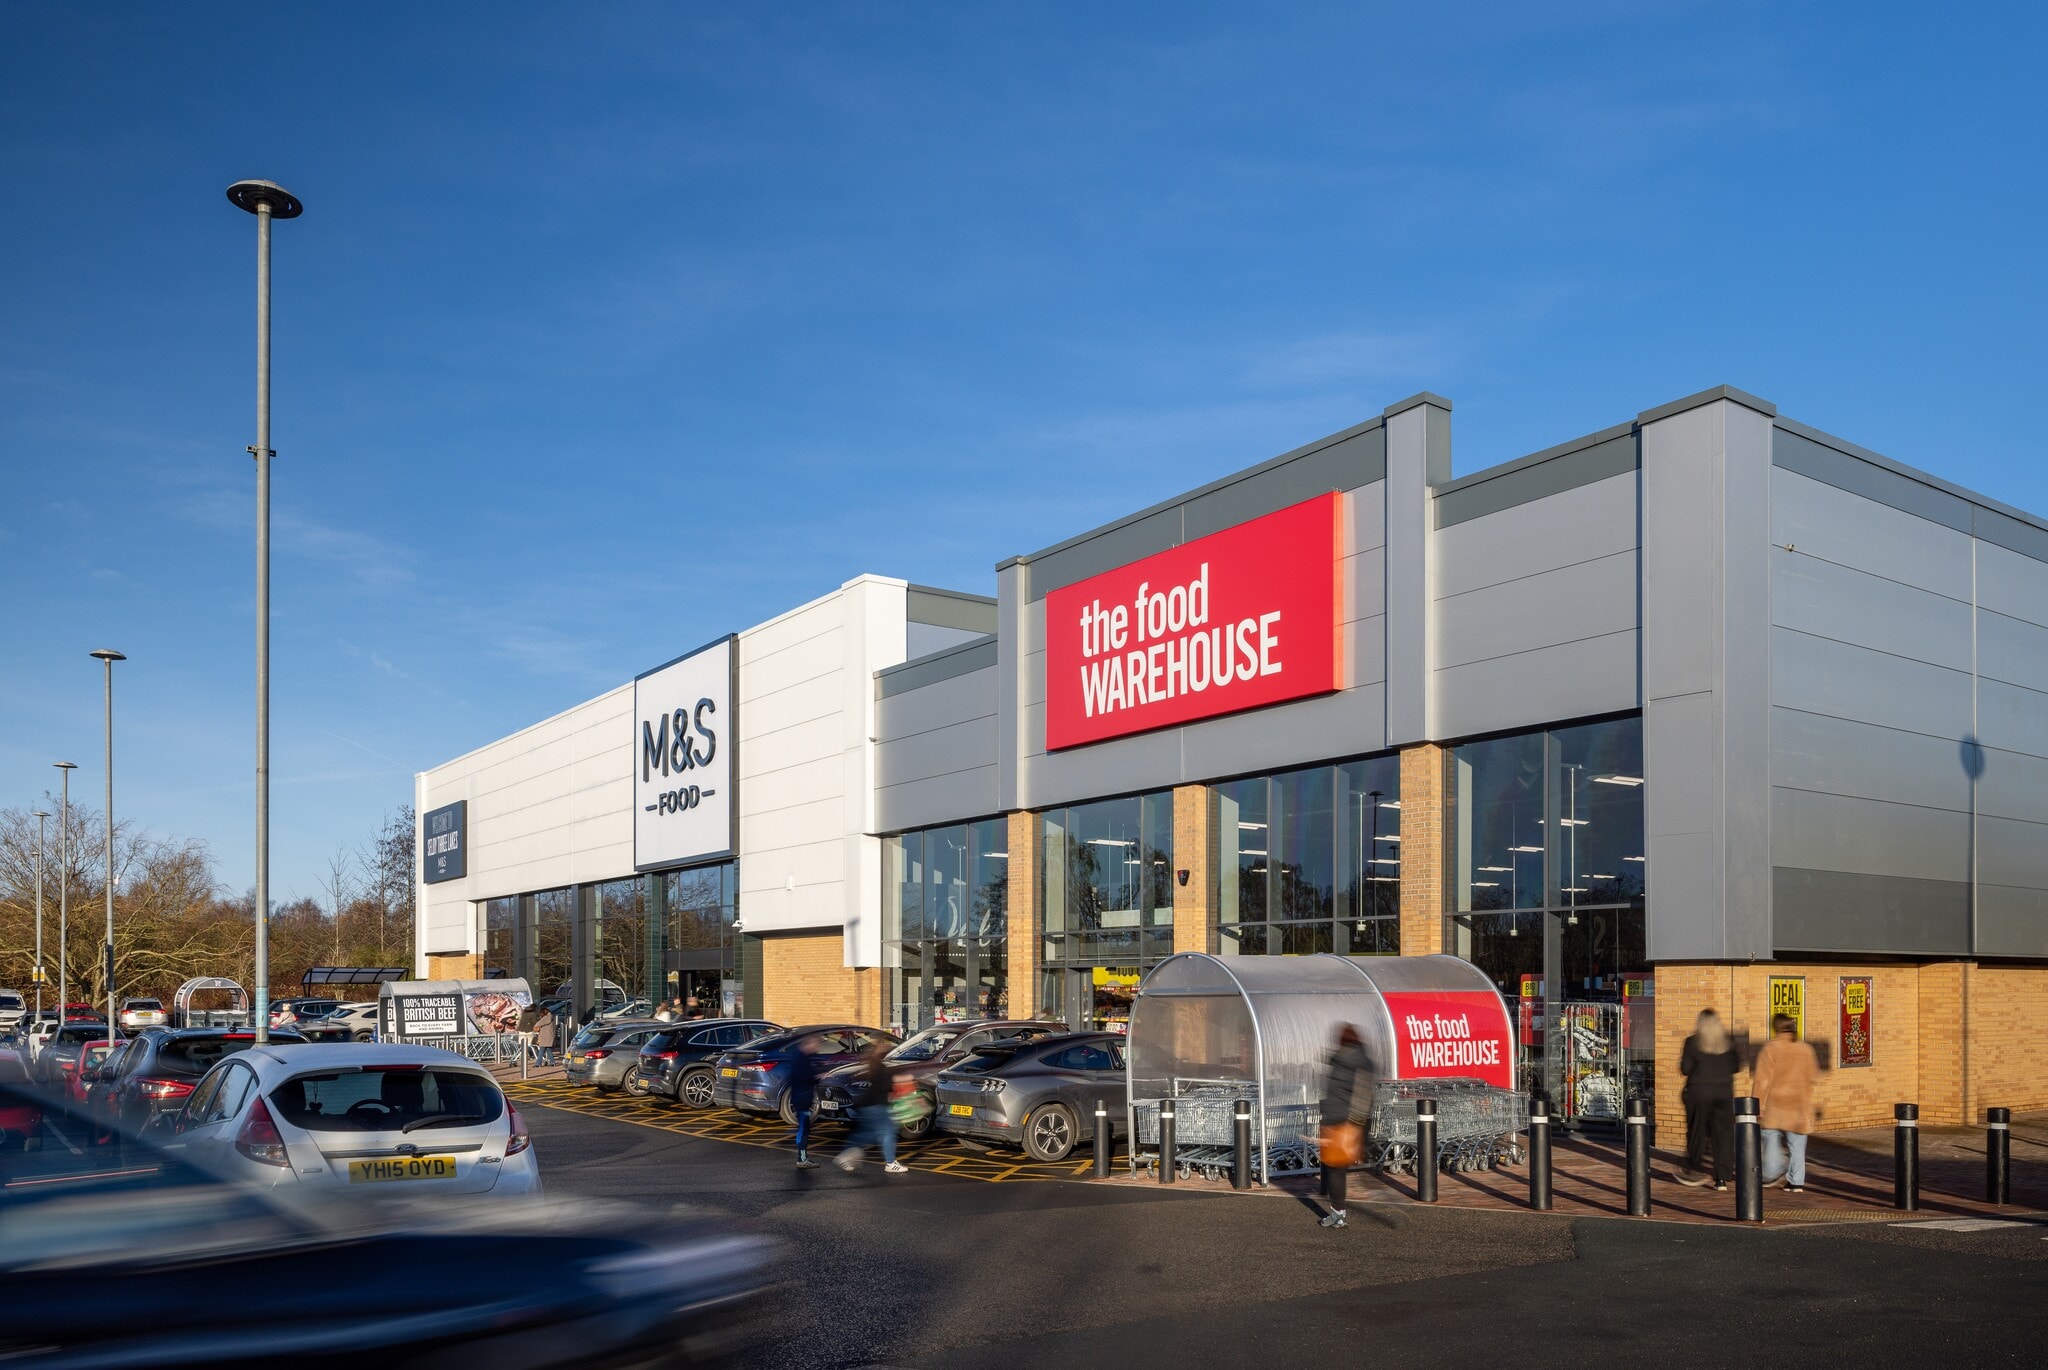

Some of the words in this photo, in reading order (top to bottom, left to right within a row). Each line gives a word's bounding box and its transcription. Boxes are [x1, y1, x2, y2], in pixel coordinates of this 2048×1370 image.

[1080, 599, 1128, 657] the
[1135, 562, 1208, 642] food
[1081, 610, 1282, 718] WAREHOUSE
[643, 698, 716, 782] M&S
[403, 998, 421, 1008] 100%
[421, 997, 456, 1007] TRACEABLE
[1774, 984, 1800, 1006] DEAL
[1849, 995, 1864, 1009] FREE
[404, 1007, 436, 1021] BRITISH
[438, 1007, 456, 1020] BEEF
[1789, 1006, 1800, 1016] WEEK
[1406, 1014, 1434, 1040] the
[1434, 1013, 1470, 1039] food
[1410, 1039, 1500, 1068] WAREHOUSE
[361, 1161, 404, 1179] YH15
[409, 1159, 445, 1176] OYD
